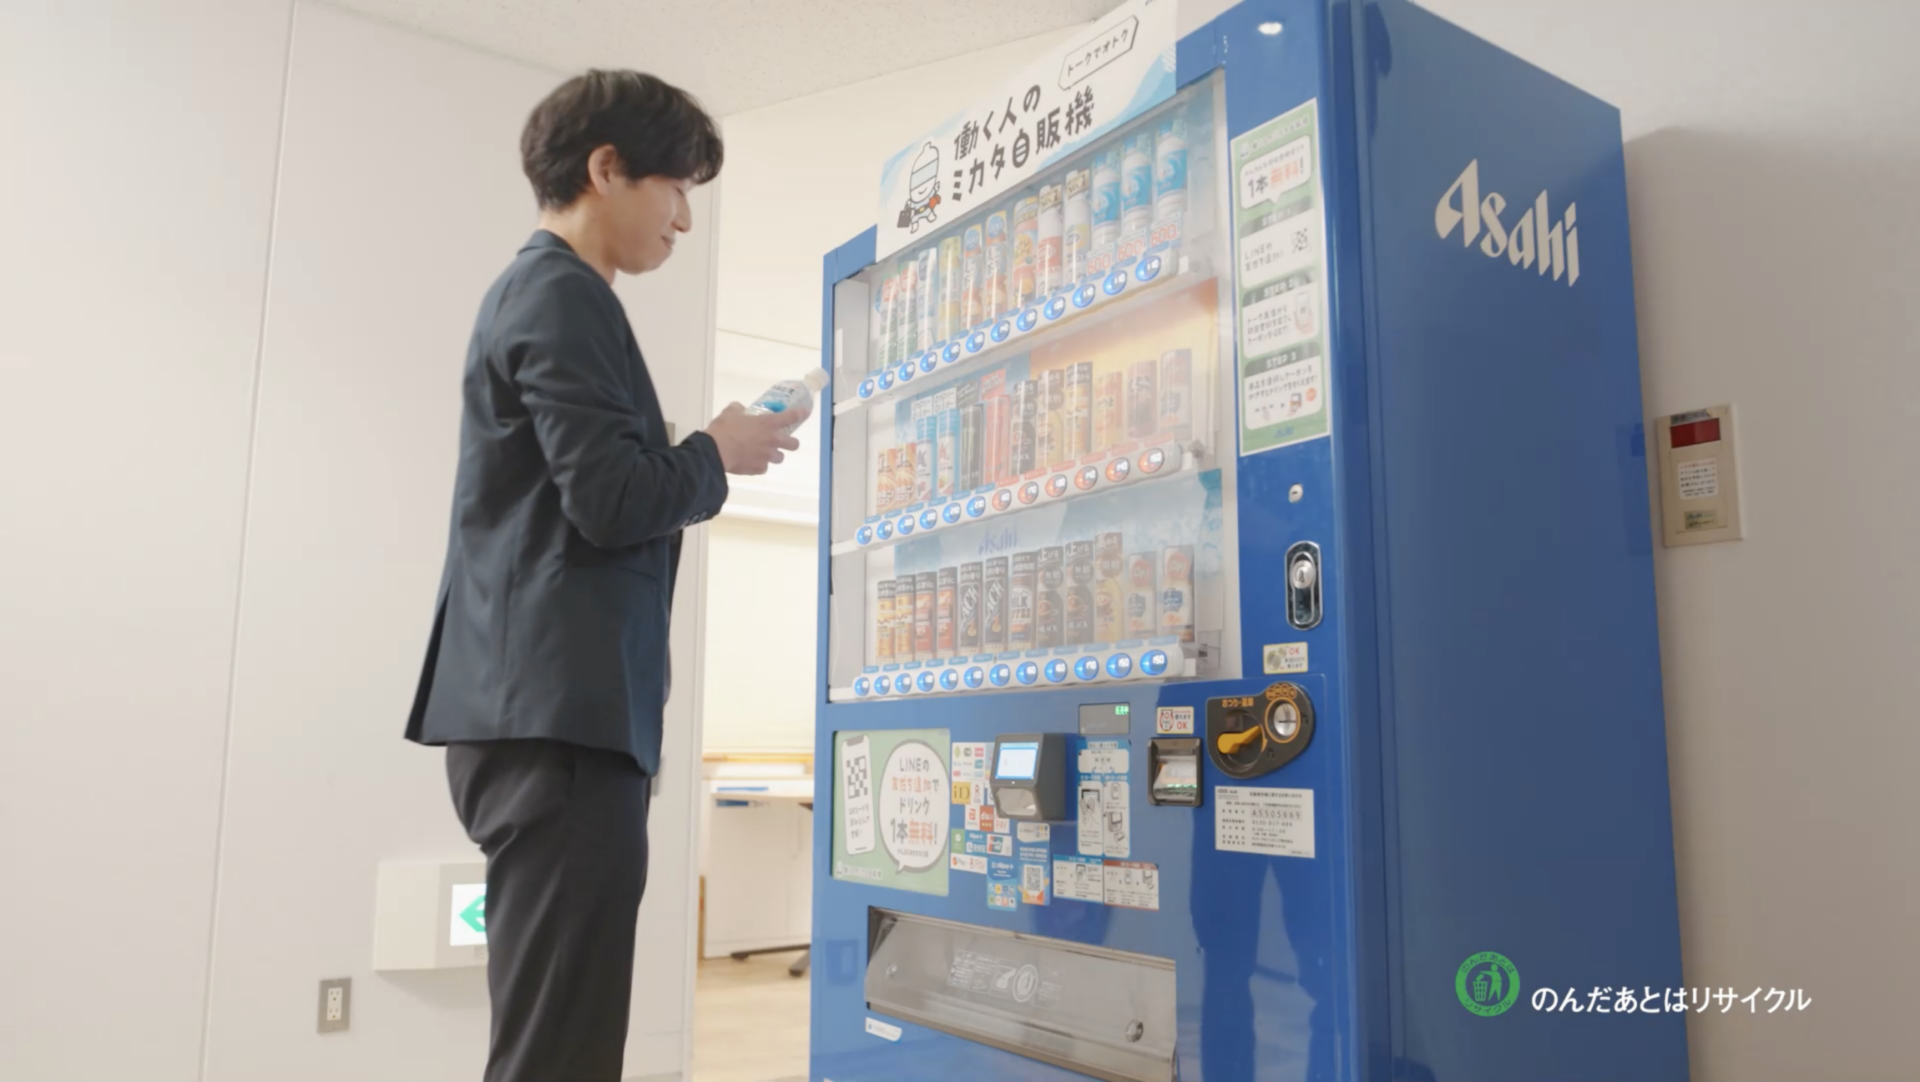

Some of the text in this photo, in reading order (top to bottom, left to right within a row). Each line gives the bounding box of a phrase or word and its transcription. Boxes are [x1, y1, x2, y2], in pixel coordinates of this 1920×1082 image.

[1066, 27, 1129, 77] トークでオトク
[954, 84, 1041, 162] 働く人の
[952, 85, 1095, 202] ミカタ自販機
[1248, 156, 1304, 197] 1本無料!
[1435, 158, 1580, 287] Asahi
[1150, 223, 1177, 248] 600
[1117, 239, 1144, 262] 600
[1266, 353, 1289, 369] STEP
[1287, 647, 1300, 656] OK
[1176, 720, 1188, 731] OK
[899, 757, 930, 773] LINEの
[891, 776, 940, 794] 友だち追加で
[953, 785, 971, 801] iD
[899, 797, 931, 816] ドリンク
[890, 818, 939, 846] 1本無料!
